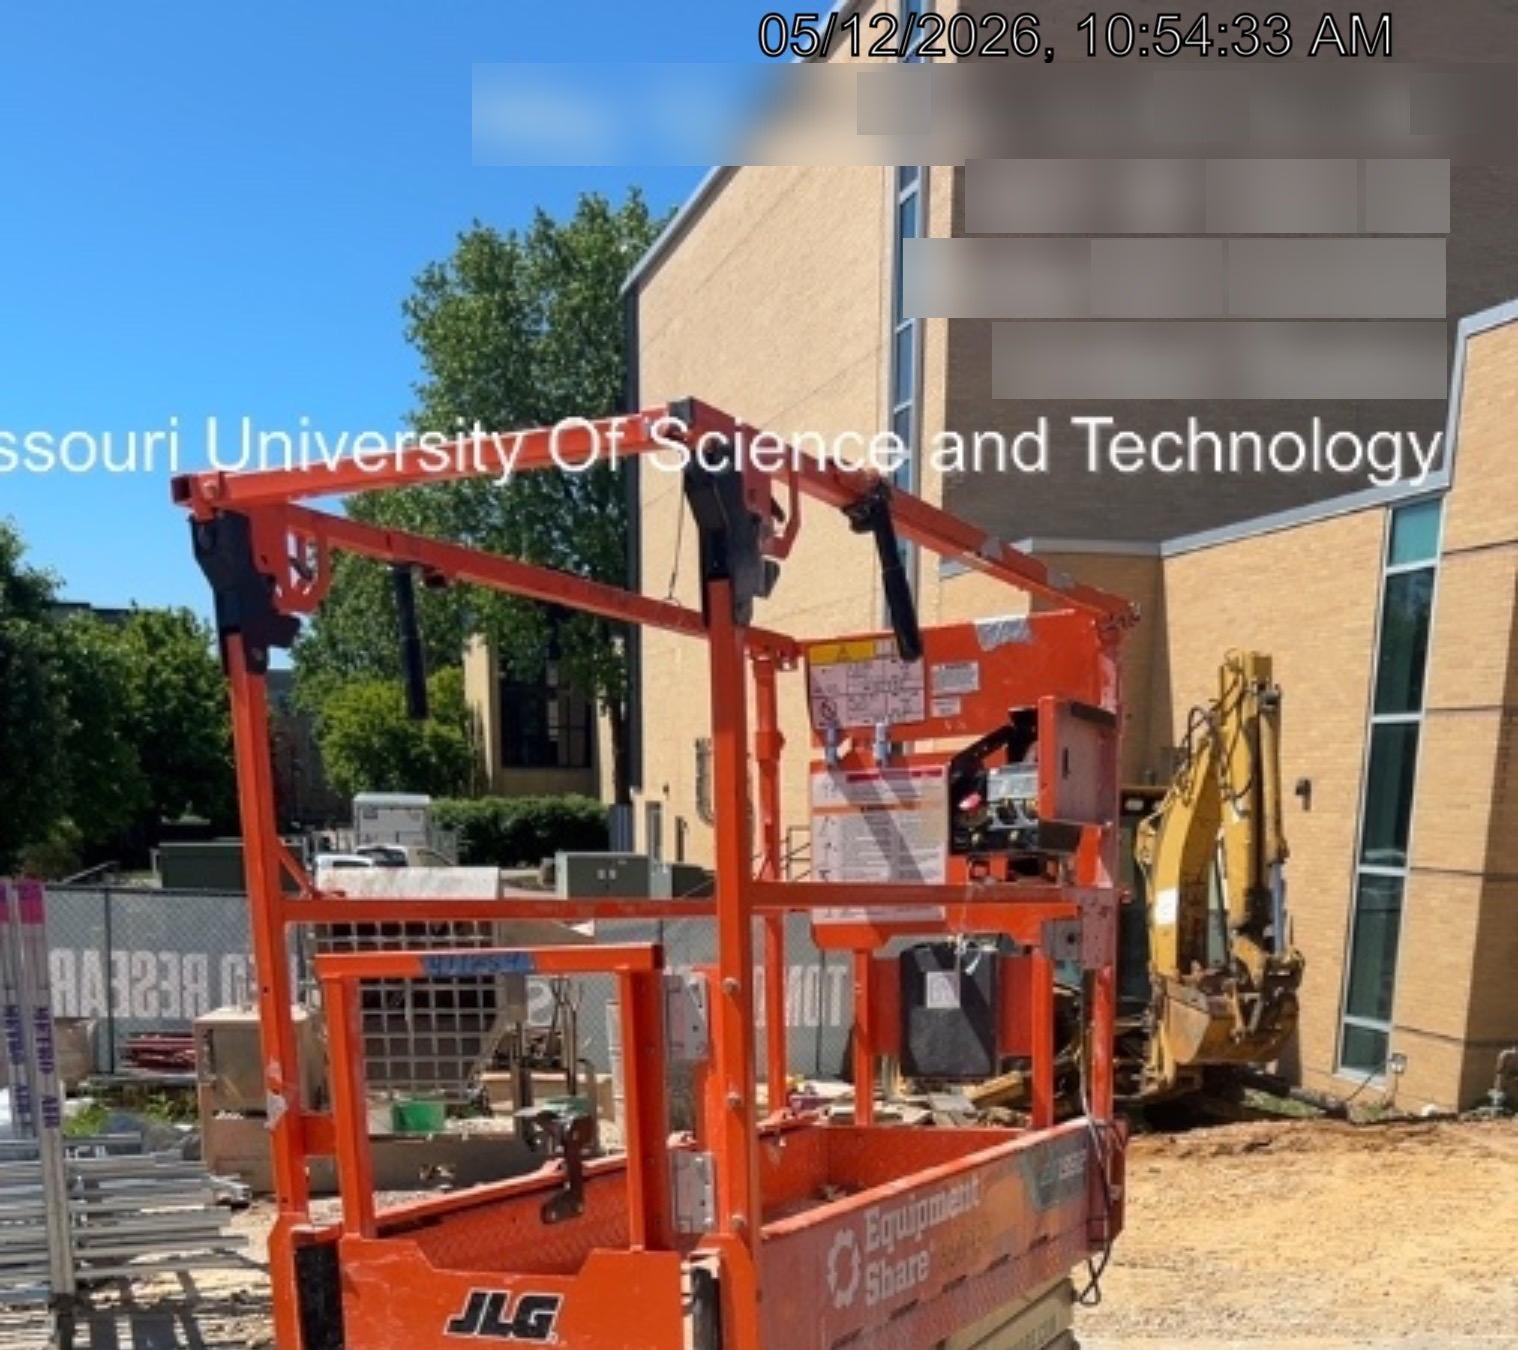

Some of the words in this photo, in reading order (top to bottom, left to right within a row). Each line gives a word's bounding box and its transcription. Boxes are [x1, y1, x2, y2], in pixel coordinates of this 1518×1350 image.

[864, 1174, 980, 1252] Equipment
[864, 1249, 931, 1304] Share
[443, 1287, 564, 1343] JLG
